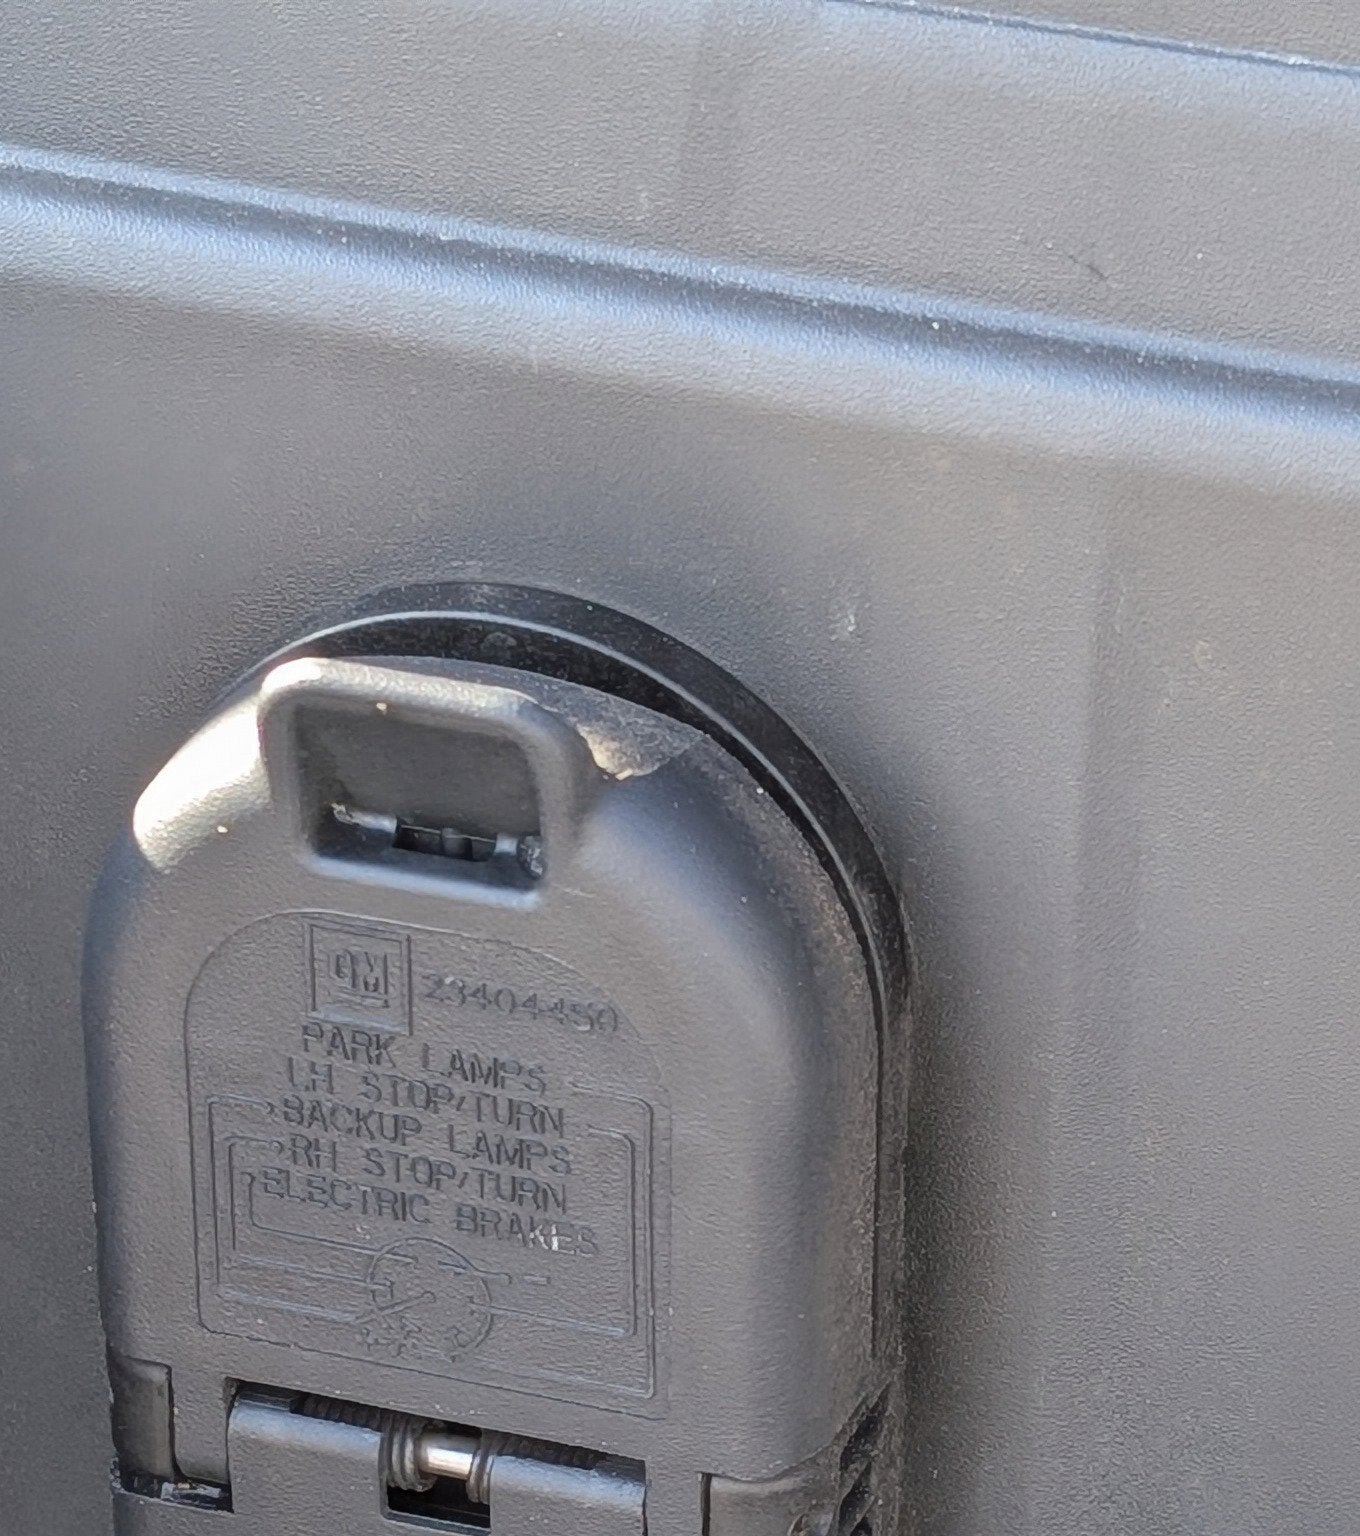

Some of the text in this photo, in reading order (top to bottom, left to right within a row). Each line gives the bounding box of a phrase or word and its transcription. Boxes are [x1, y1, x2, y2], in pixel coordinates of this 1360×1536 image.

[287, 1057, 565, 1139] LH STOP/TURN
[301, 1022, 546, 1095] PARK LAMPS
[283, 1094, 573, 1176] BACKUP LAMPS
[290, 1133, 568, 1214] RH STOP/TURN
[263, 1168, 600, 1258] ELECTRIC BRAKES
